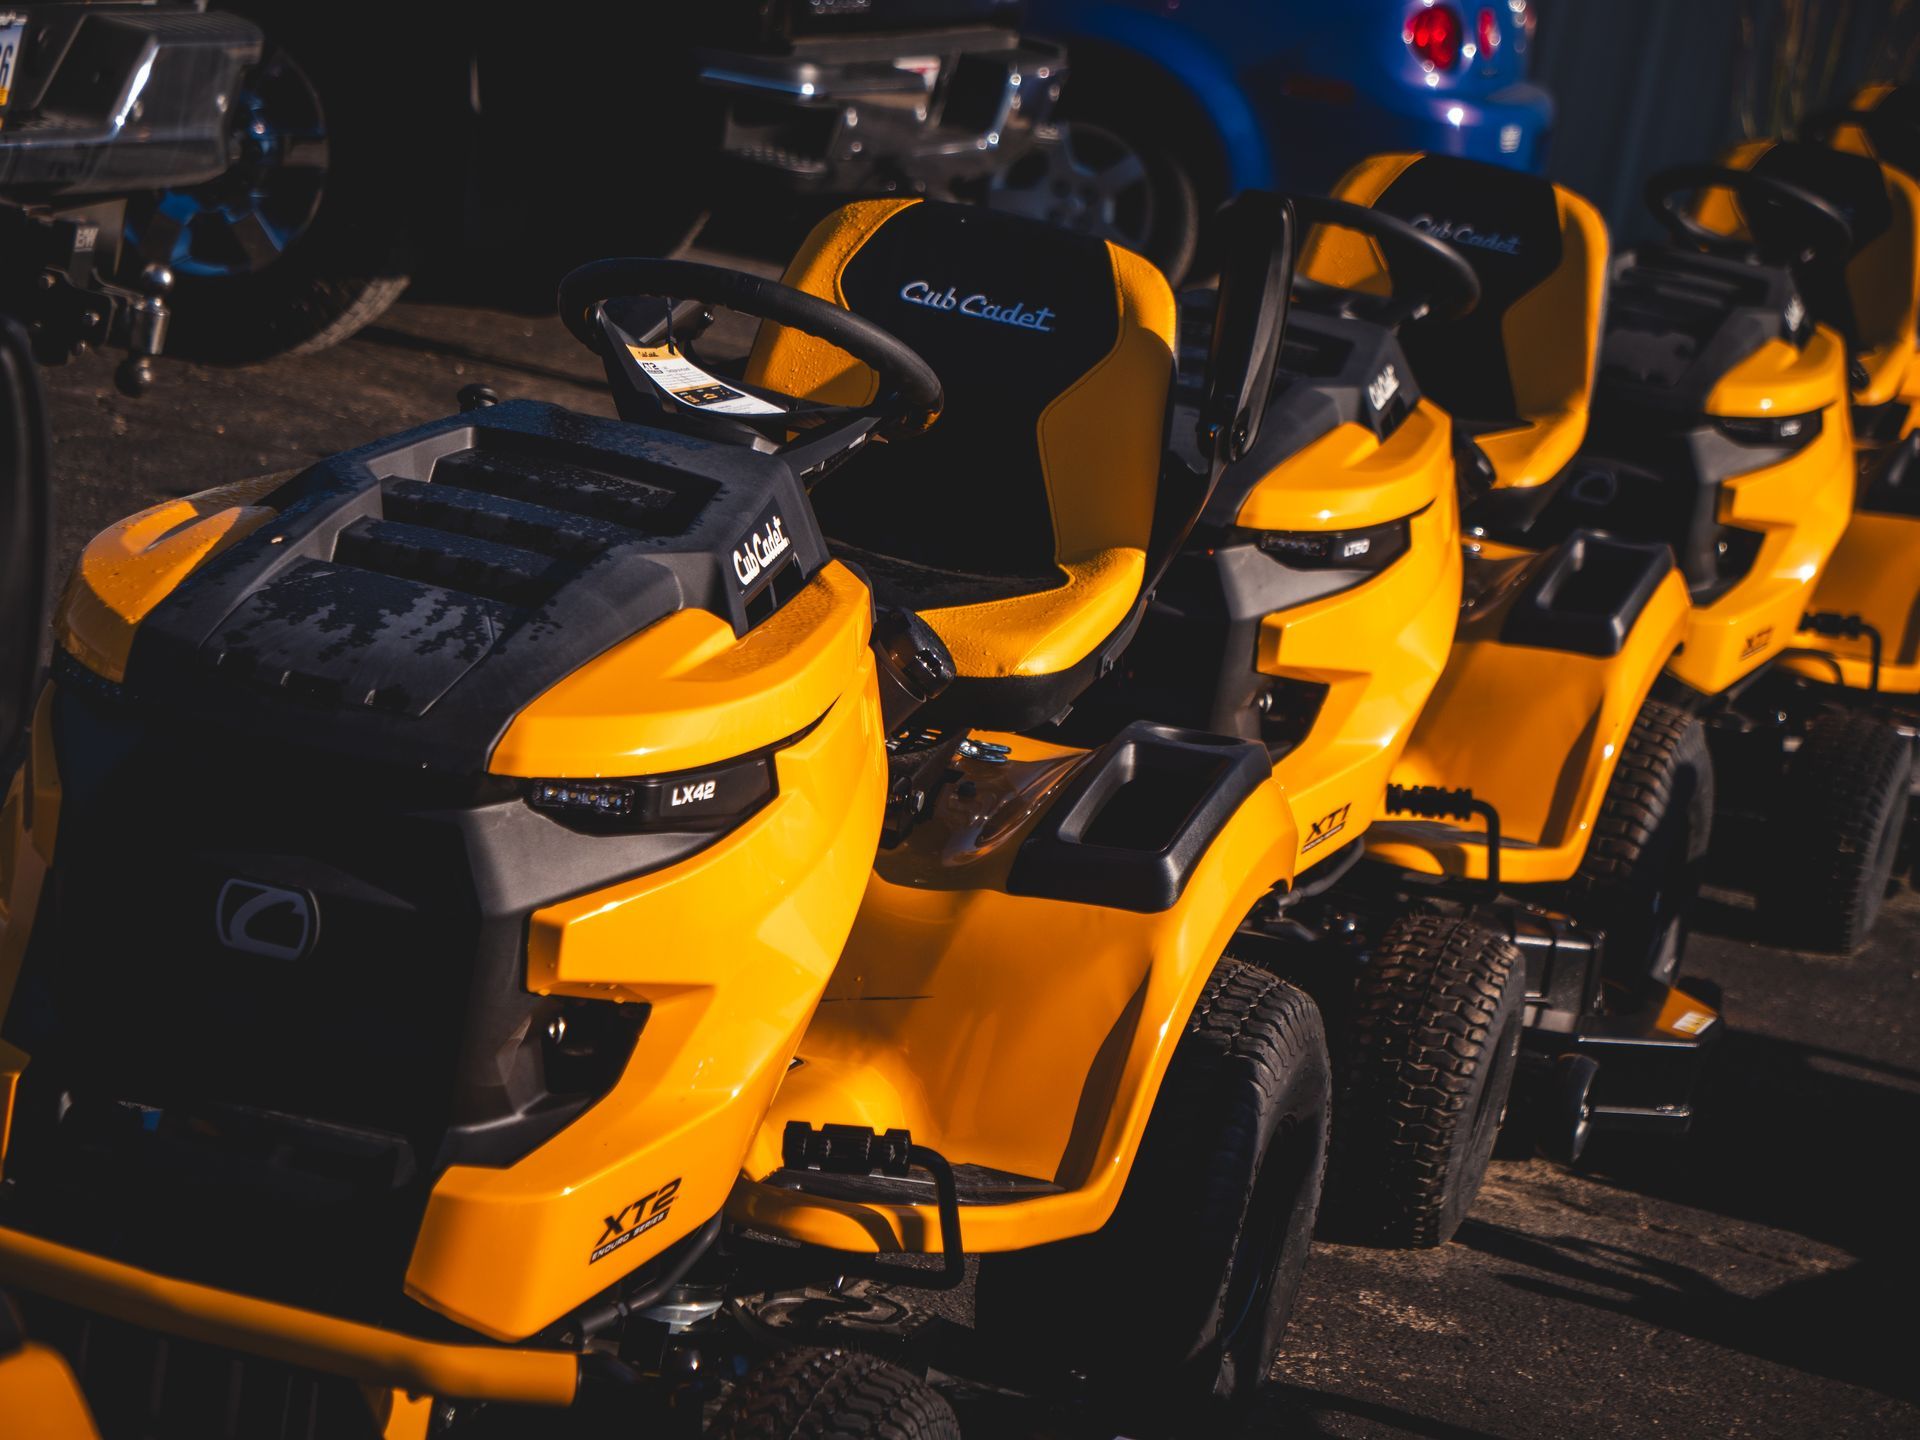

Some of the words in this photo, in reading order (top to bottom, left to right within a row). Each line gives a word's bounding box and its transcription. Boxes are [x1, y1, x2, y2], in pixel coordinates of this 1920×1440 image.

[900, 280, 957, 311] Cub
[959, 294, 1056, 332] Cadet
[733, 542, 760, 586] Cub
[752, 515, 789, 568] Cadet
[671, 780, 716, 806] LX42
[1305, 801, 1352, 843] XT1
[590, 1233, 631, 1262] ENDURO
[633, 1211, 666, 1236] SERIES
[594, 1177, 682, 1248] XT2
